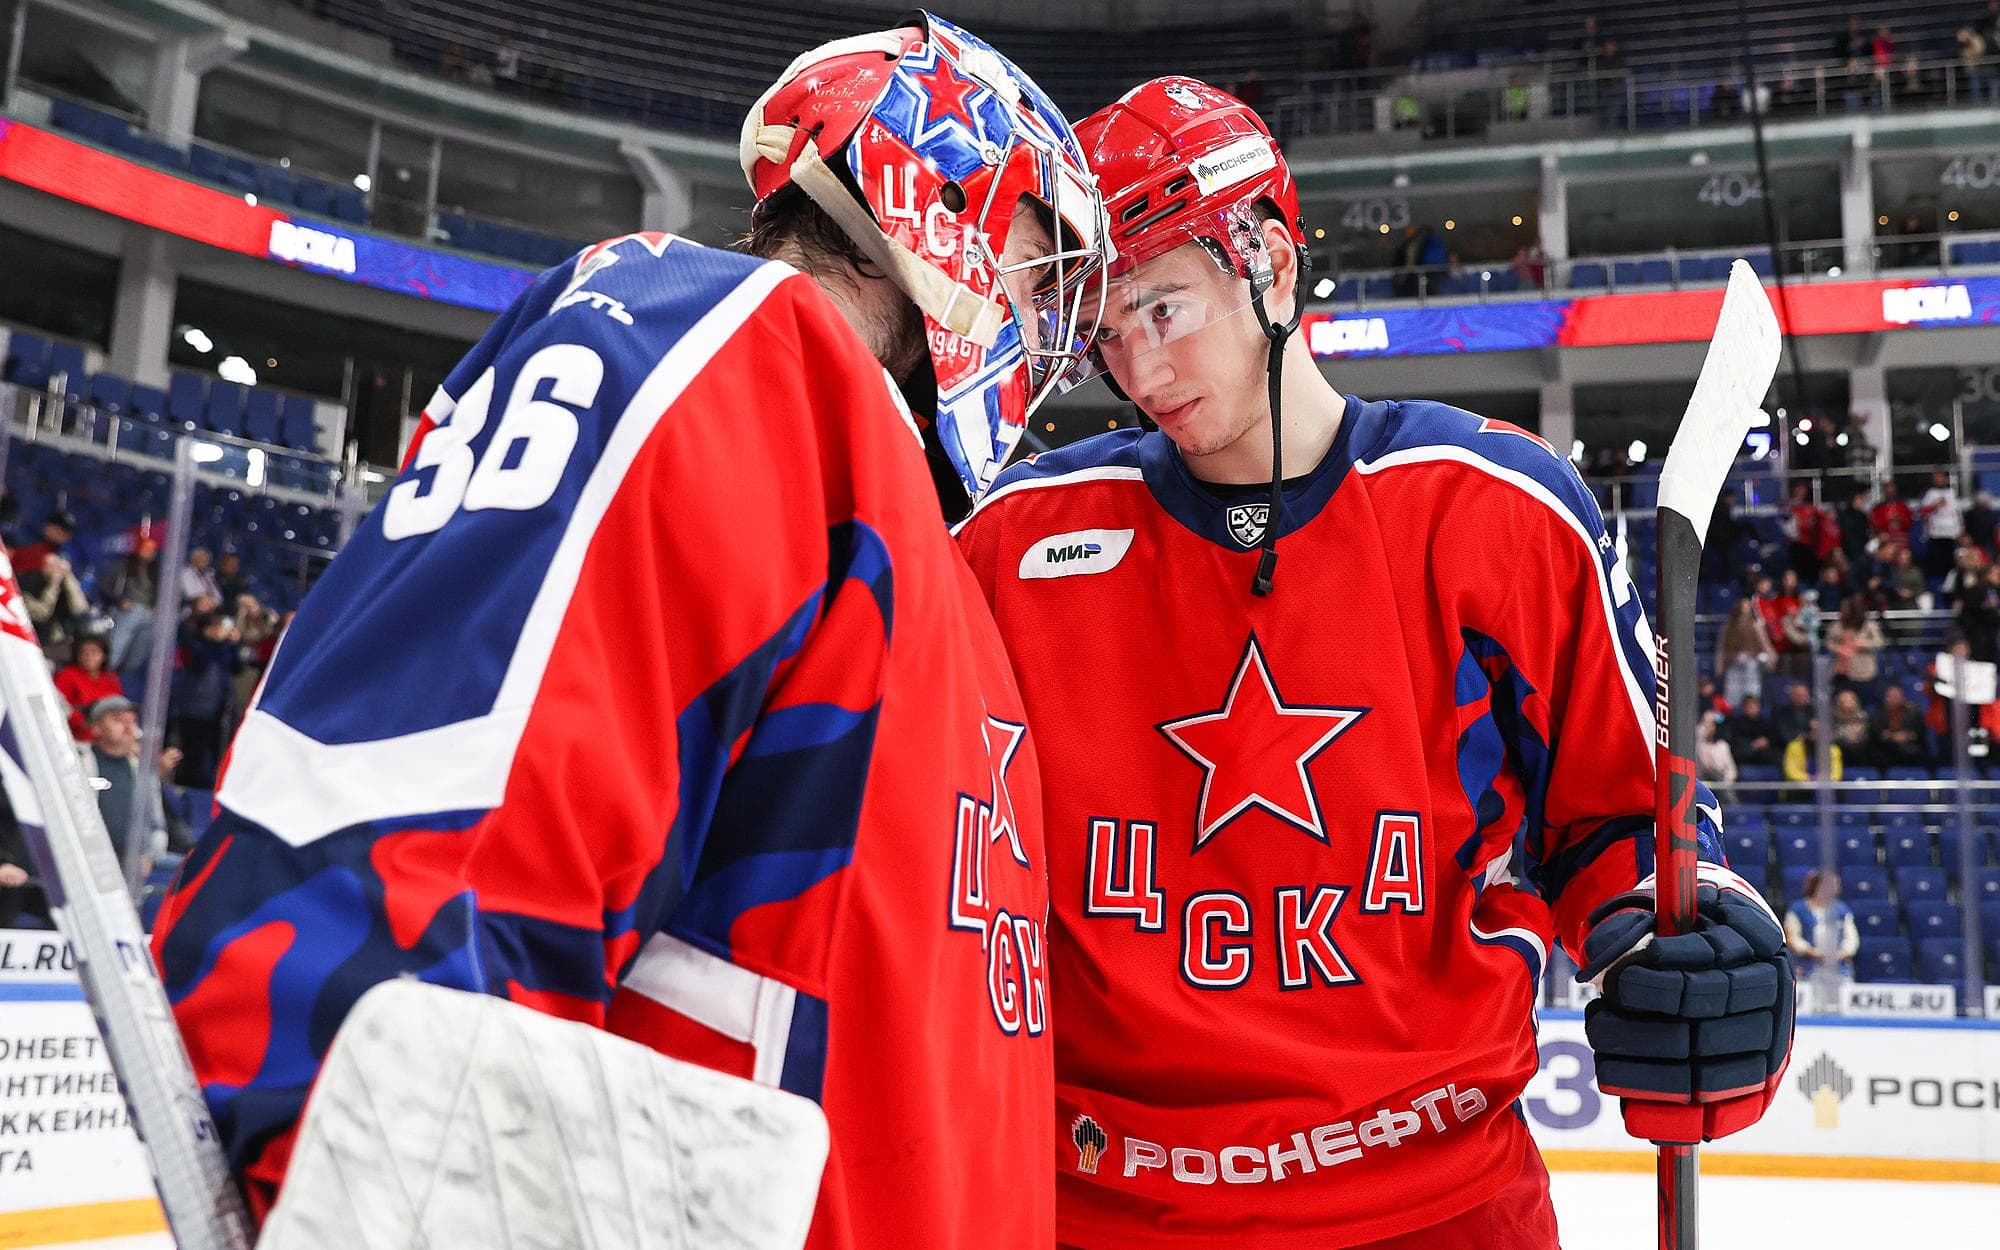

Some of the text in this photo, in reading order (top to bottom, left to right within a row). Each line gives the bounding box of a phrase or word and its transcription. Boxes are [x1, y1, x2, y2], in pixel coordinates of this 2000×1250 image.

[1212, 147, 1269, 175] РОСНЕФТЬ
[1342, 199, 1410, 231] 403
[383, 343, 604, 541] 36
[1046, 543, 1102, 563] МИР
[1083, 809, 1426, 993] ЦСКА
[1850, 992, 1945, 1011] KHL.RU
[1869, 1078, 2000, 1109] РОС
[1124, 1083, 1488, 1185] РОСНЕФТЬ
